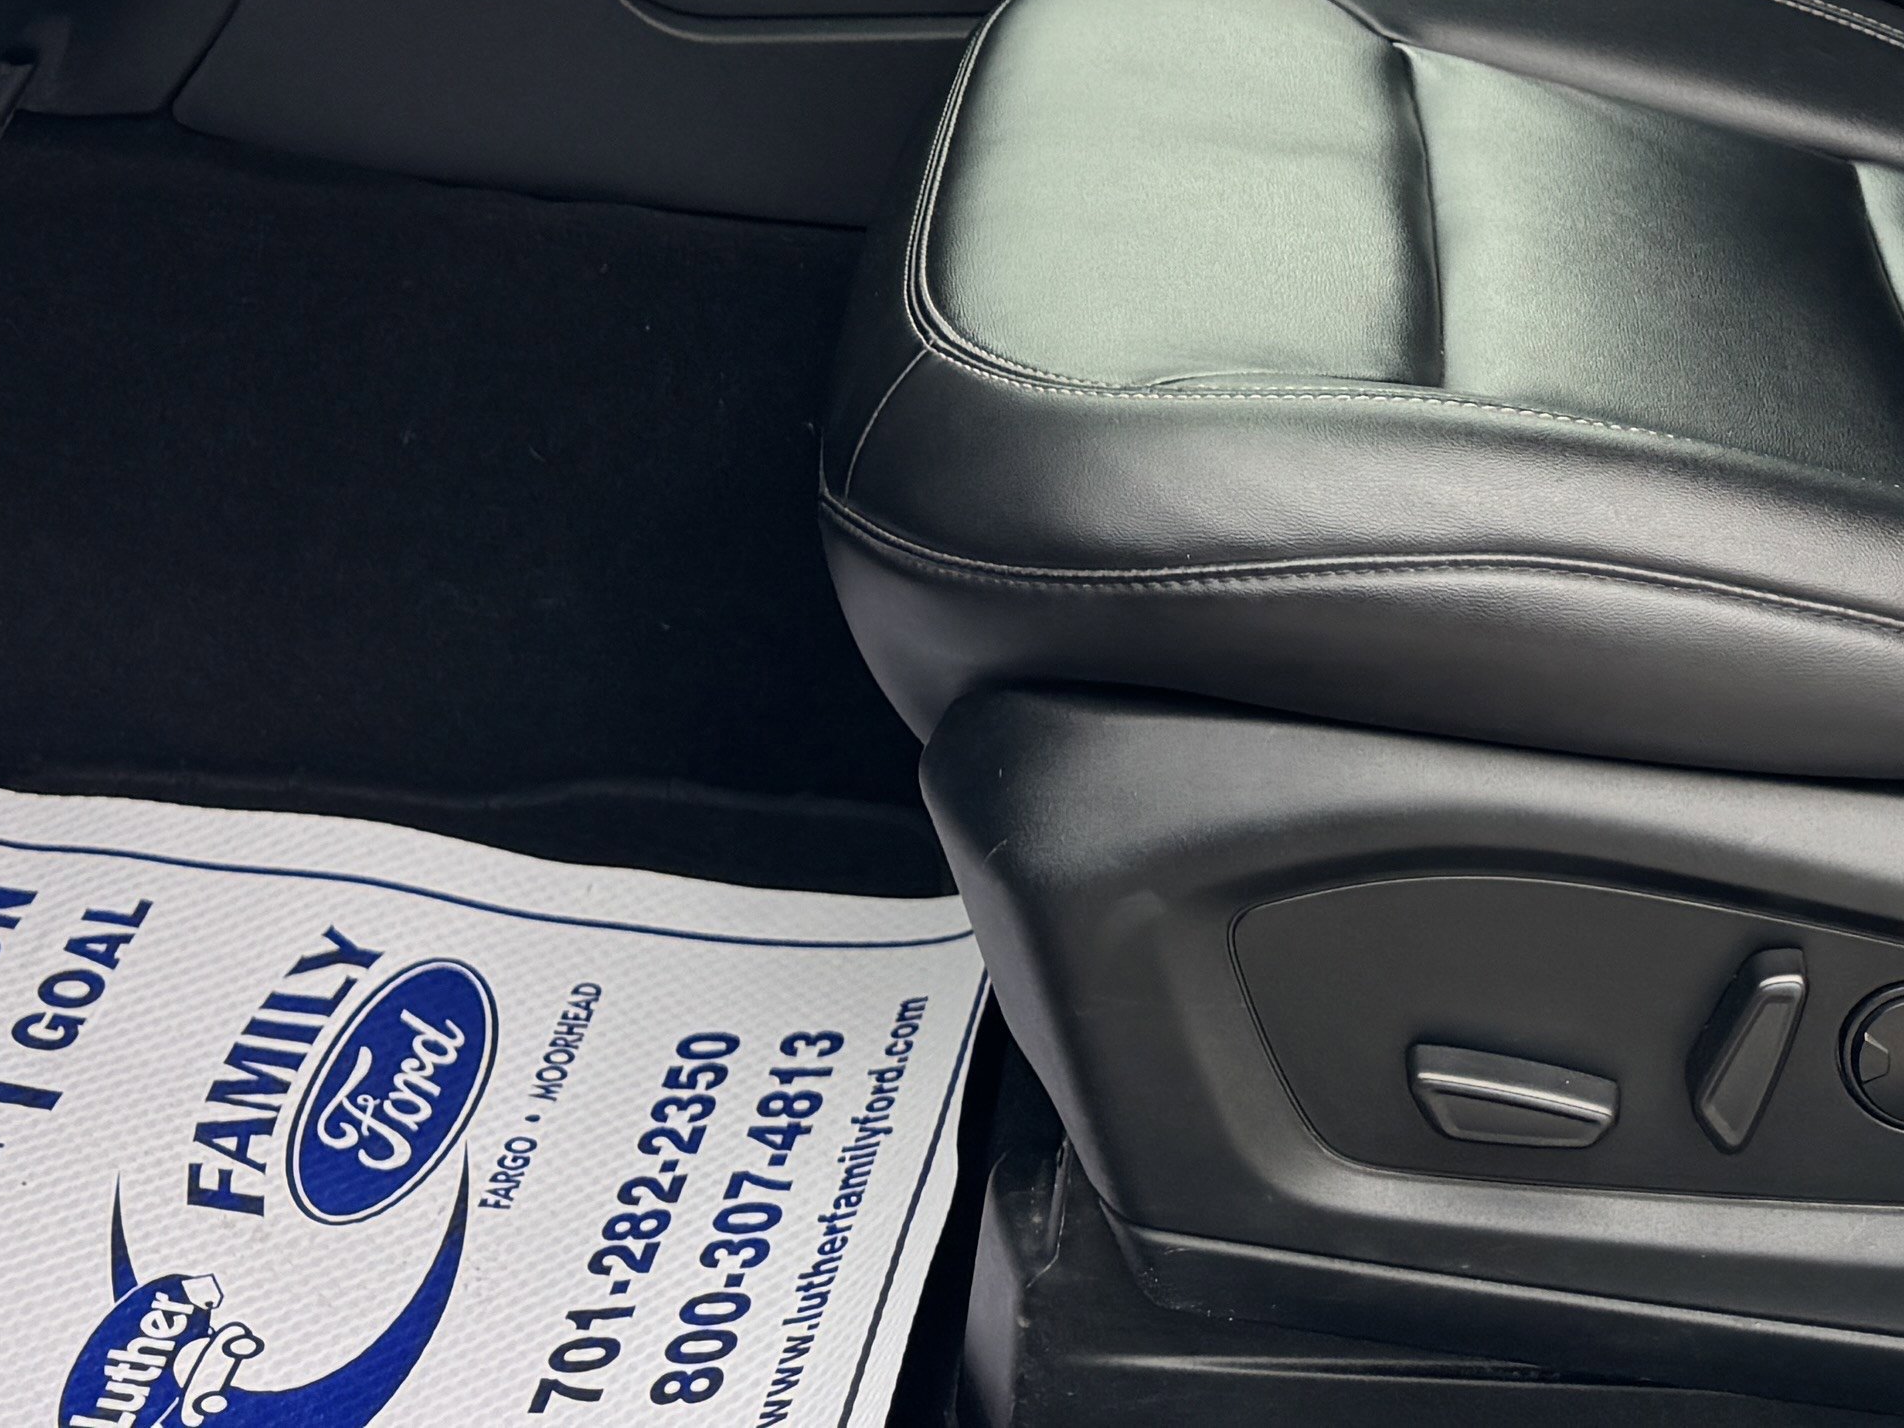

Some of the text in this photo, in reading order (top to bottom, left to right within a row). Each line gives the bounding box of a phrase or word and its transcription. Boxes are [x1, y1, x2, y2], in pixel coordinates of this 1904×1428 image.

[11, 899, 154, 1051] GOAL
[186, 924, 386, 1217] FAMILY
[317, 1008, 466, 1171] Ford
[478, 982, 602, 1210] FARGO MOORHEAD
[527, 1030, 741, 1414] 701-282-2350
[649, 1029, 845, 1405] 800-307-4813
[756, 995, 929, 1428] www.lutherfamilyford.com
[69, 1291, 194, 1428] Luther
